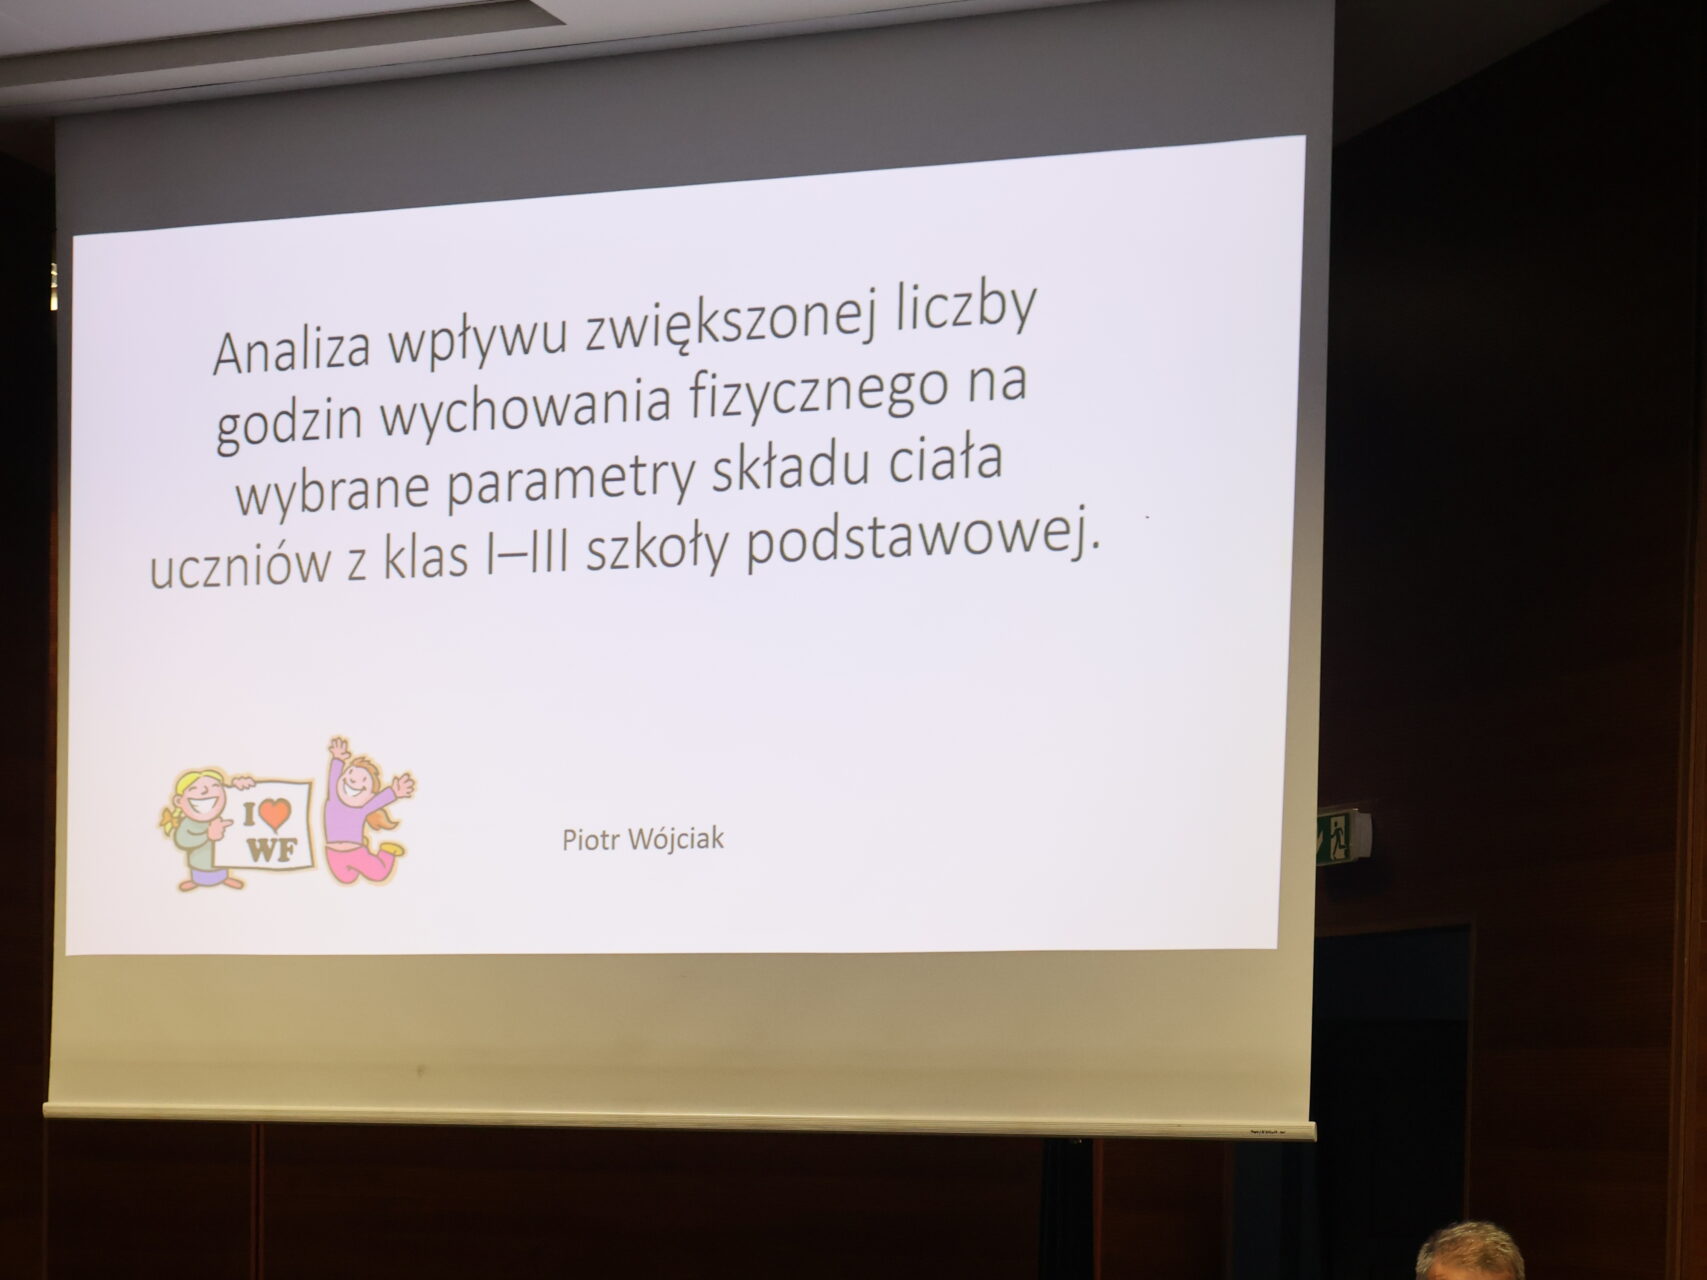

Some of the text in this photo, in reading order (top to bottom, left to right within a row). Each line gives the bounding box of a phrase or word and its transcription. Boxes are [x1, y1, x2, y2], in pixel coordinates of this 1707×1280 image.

[213, 276, 1037, 375] Analiza wpływu zwiększonej liczby
[216, 364, 1026, 457] godzin wychowania fizycznego na
[235, 430, 1002, 525] wybrane parametry składu ciała
[151, 538, 332, 589] uczniów
[347, 548, 366, 581] z
[385, 531, 468, 579] klas
[586, 518, 729, 577] szkoły
[747, 504, 1100, 575] podstawowej.
[246, 838, 298, 863] WF
[563, 824, 724, 855] Piotr Wójciak
